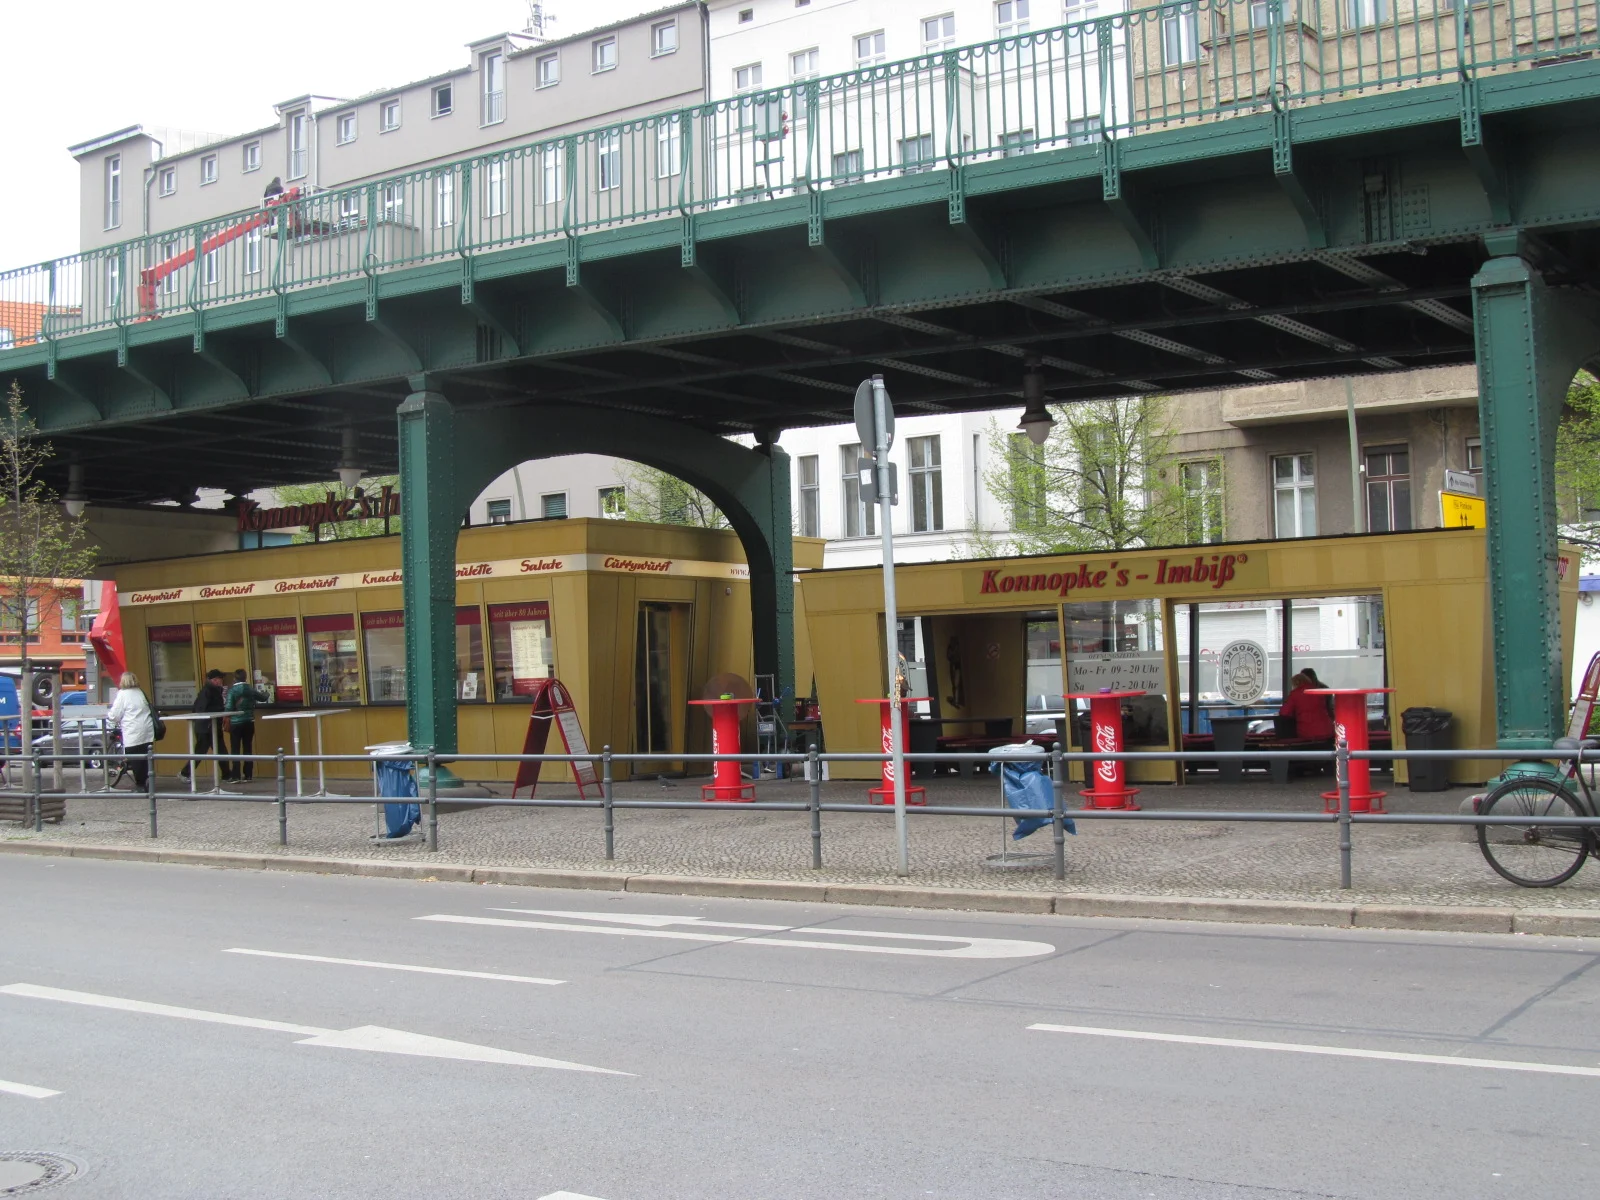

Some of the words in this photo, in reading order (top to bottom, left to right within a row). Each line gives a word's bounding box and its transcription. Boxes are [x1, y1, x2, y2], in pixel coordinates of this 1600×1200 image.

[238, 487, 372, 532] Konnopke's
[520, 559, 562, 572] Salate
[980, 561, 1129, 597] Konnopke's
[1074, 667, 1087, 676] Mo
[1096, 666, 1107, 675] Fr
[1111, 666, 1121, 674] 09
[1130, 665, 1140, 673] 20
[1143, 664, 1159, 673] Uhr
[1074, 682, 1085, 691] Sa
[1110, 682, 1120, 690] 12
[1128, 681, 1139, 690] 20
[1141, 681, 1158, 689] Uhr
